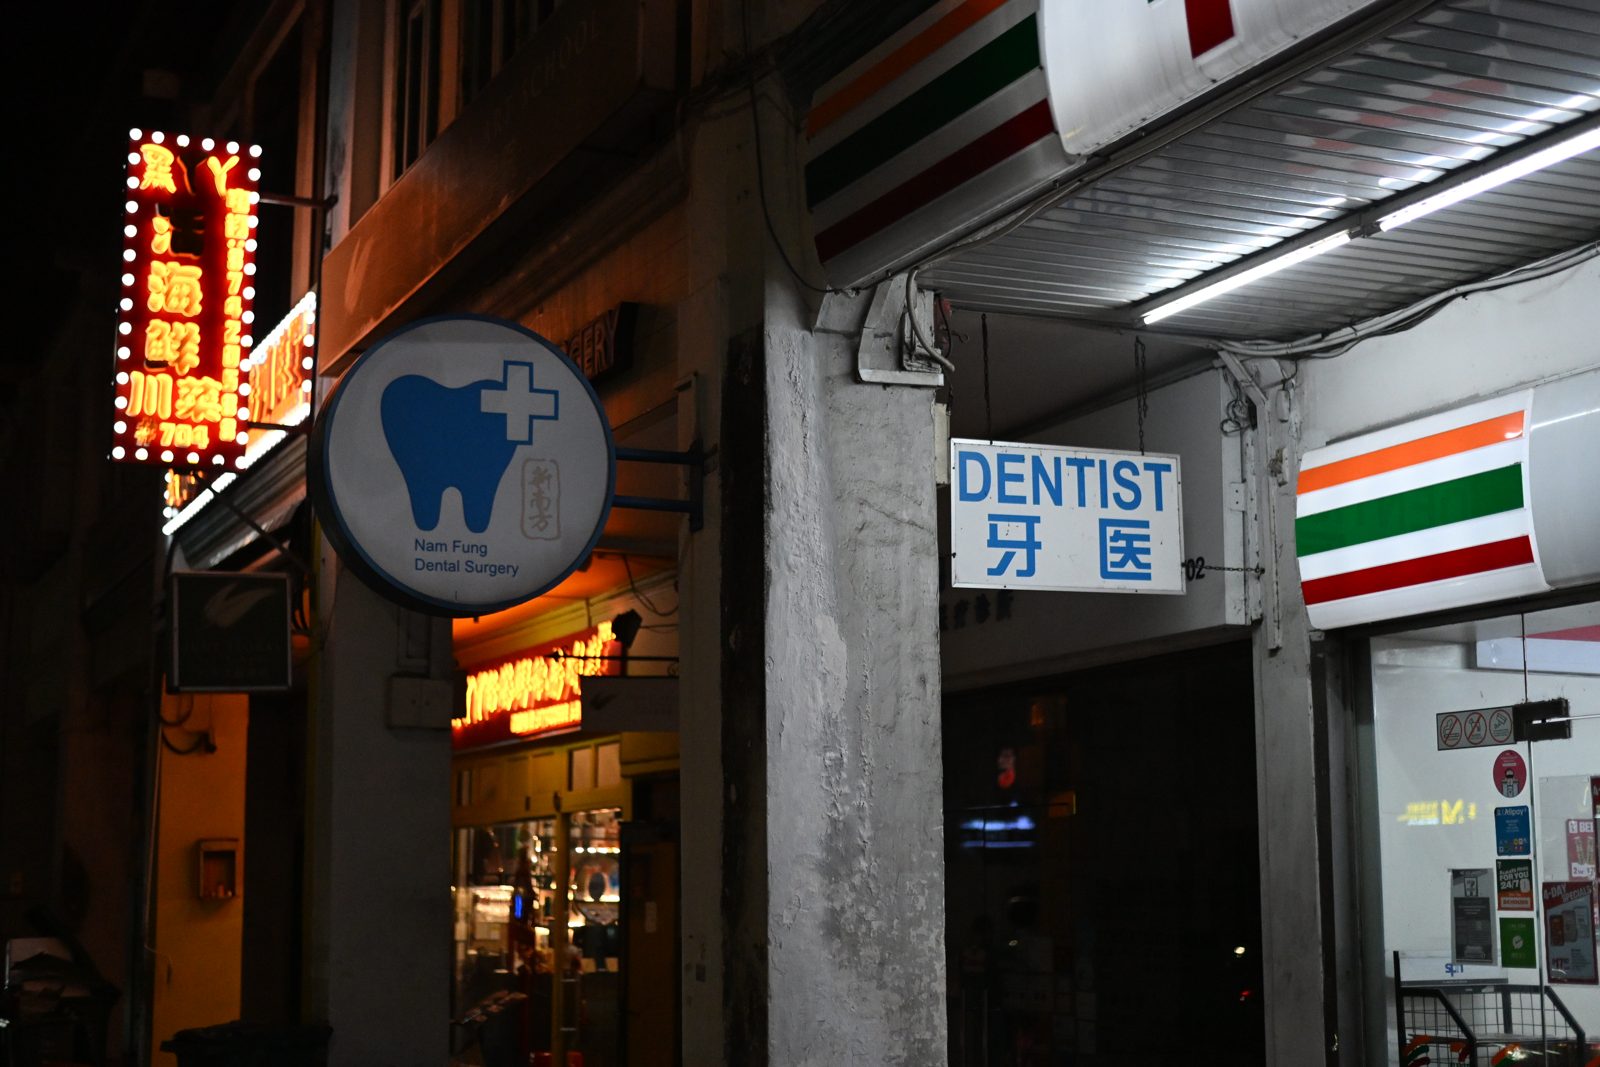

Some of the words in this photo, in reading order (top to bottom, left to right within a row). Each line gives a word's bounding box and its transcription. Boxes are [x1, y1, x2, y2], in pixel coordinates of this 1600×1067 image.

[958, 450, 1172, 512] DENTIST
[414, 539, 447, 552] Nam
[452, 540, 488, 557] Fung
[986, 513, 1152, 581] 牙医
[415, 558, 460, 572] Dental
[464, 560, 519, 577] Surgery
[1500, 879, 1519, 890] 24/7
